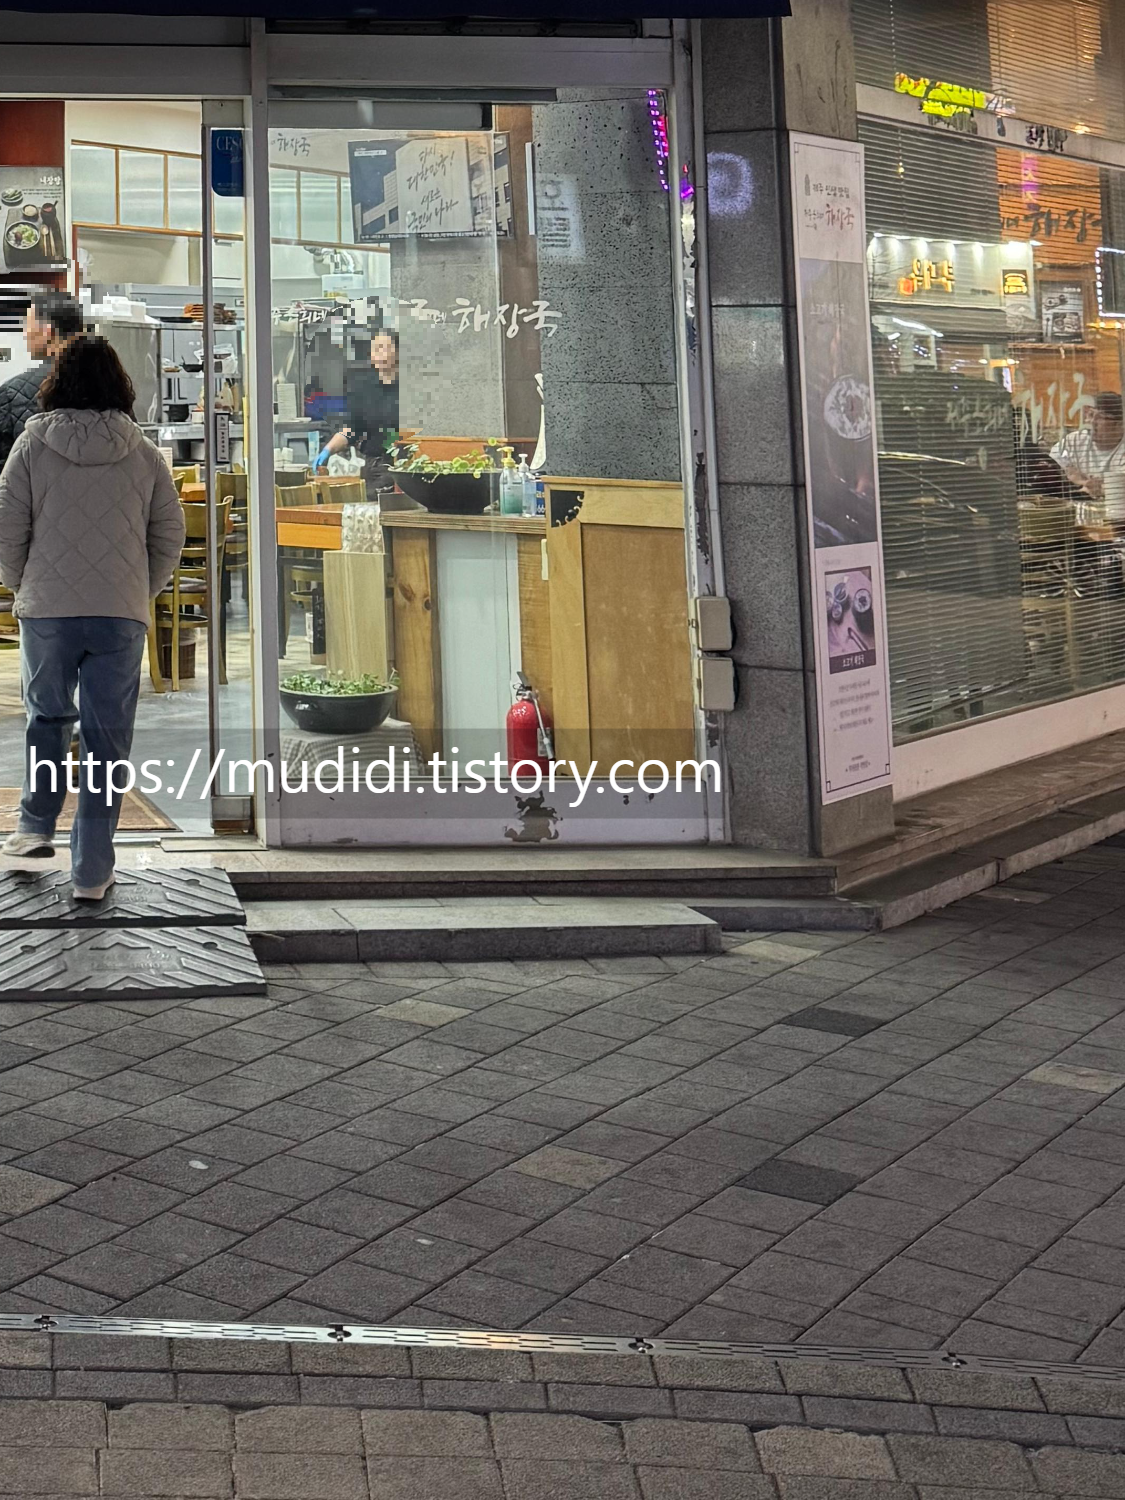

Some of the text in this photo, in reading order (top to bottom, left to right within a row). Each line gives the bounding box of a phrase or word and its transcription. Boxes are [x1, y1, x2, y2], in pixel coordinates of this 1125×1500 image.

[216, 135, 244, 151] CES
[1023, 202, 1103, 243] 해장
[453, 296, 563, 339] 해장국
